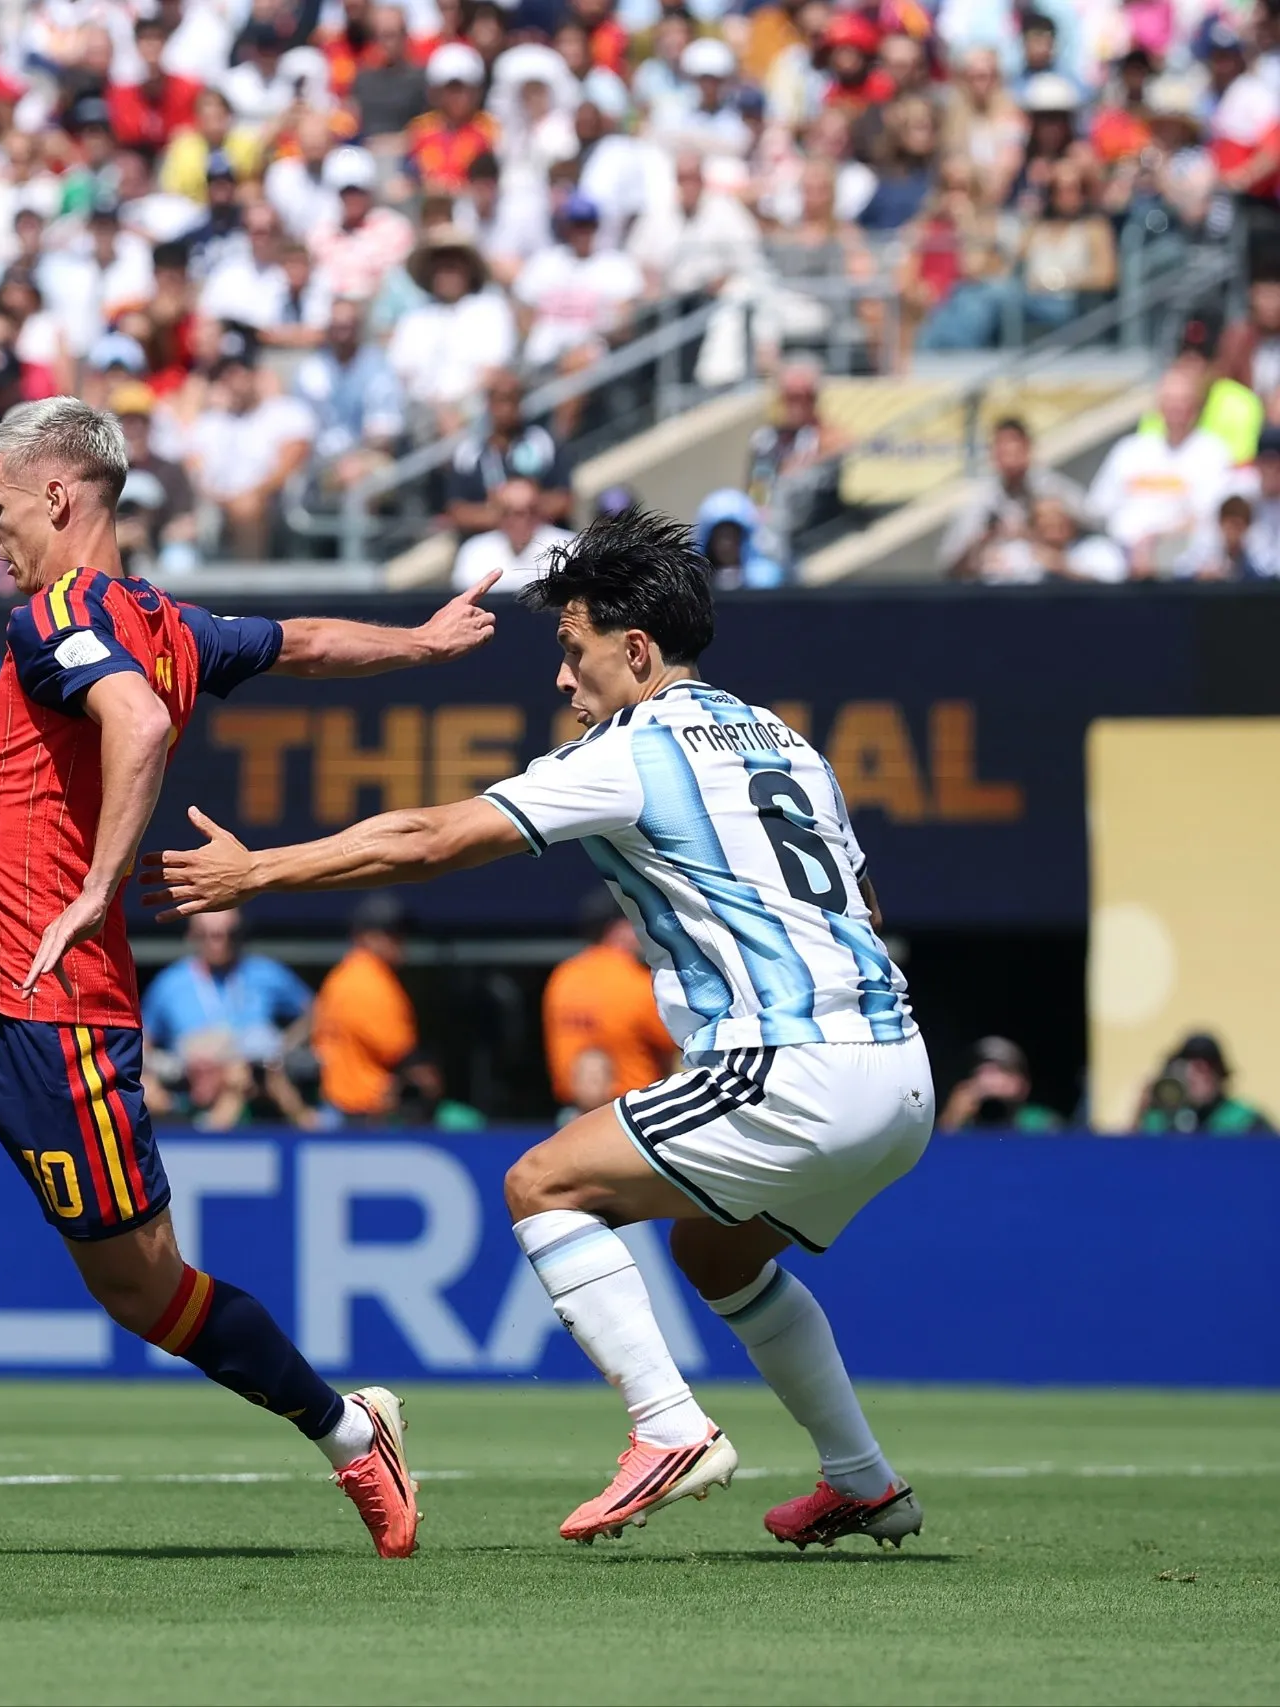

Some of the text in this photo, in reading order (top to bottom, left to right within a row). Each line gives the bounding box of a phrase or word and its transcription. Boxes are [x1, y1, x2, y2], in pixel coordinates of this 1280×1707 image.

[211, 705, 526, 826] THE
[682, 722, 805, 753] MARTINEZ
[748, 768, 848, 916] 6
[21, 1149, 84, 1218] 10
